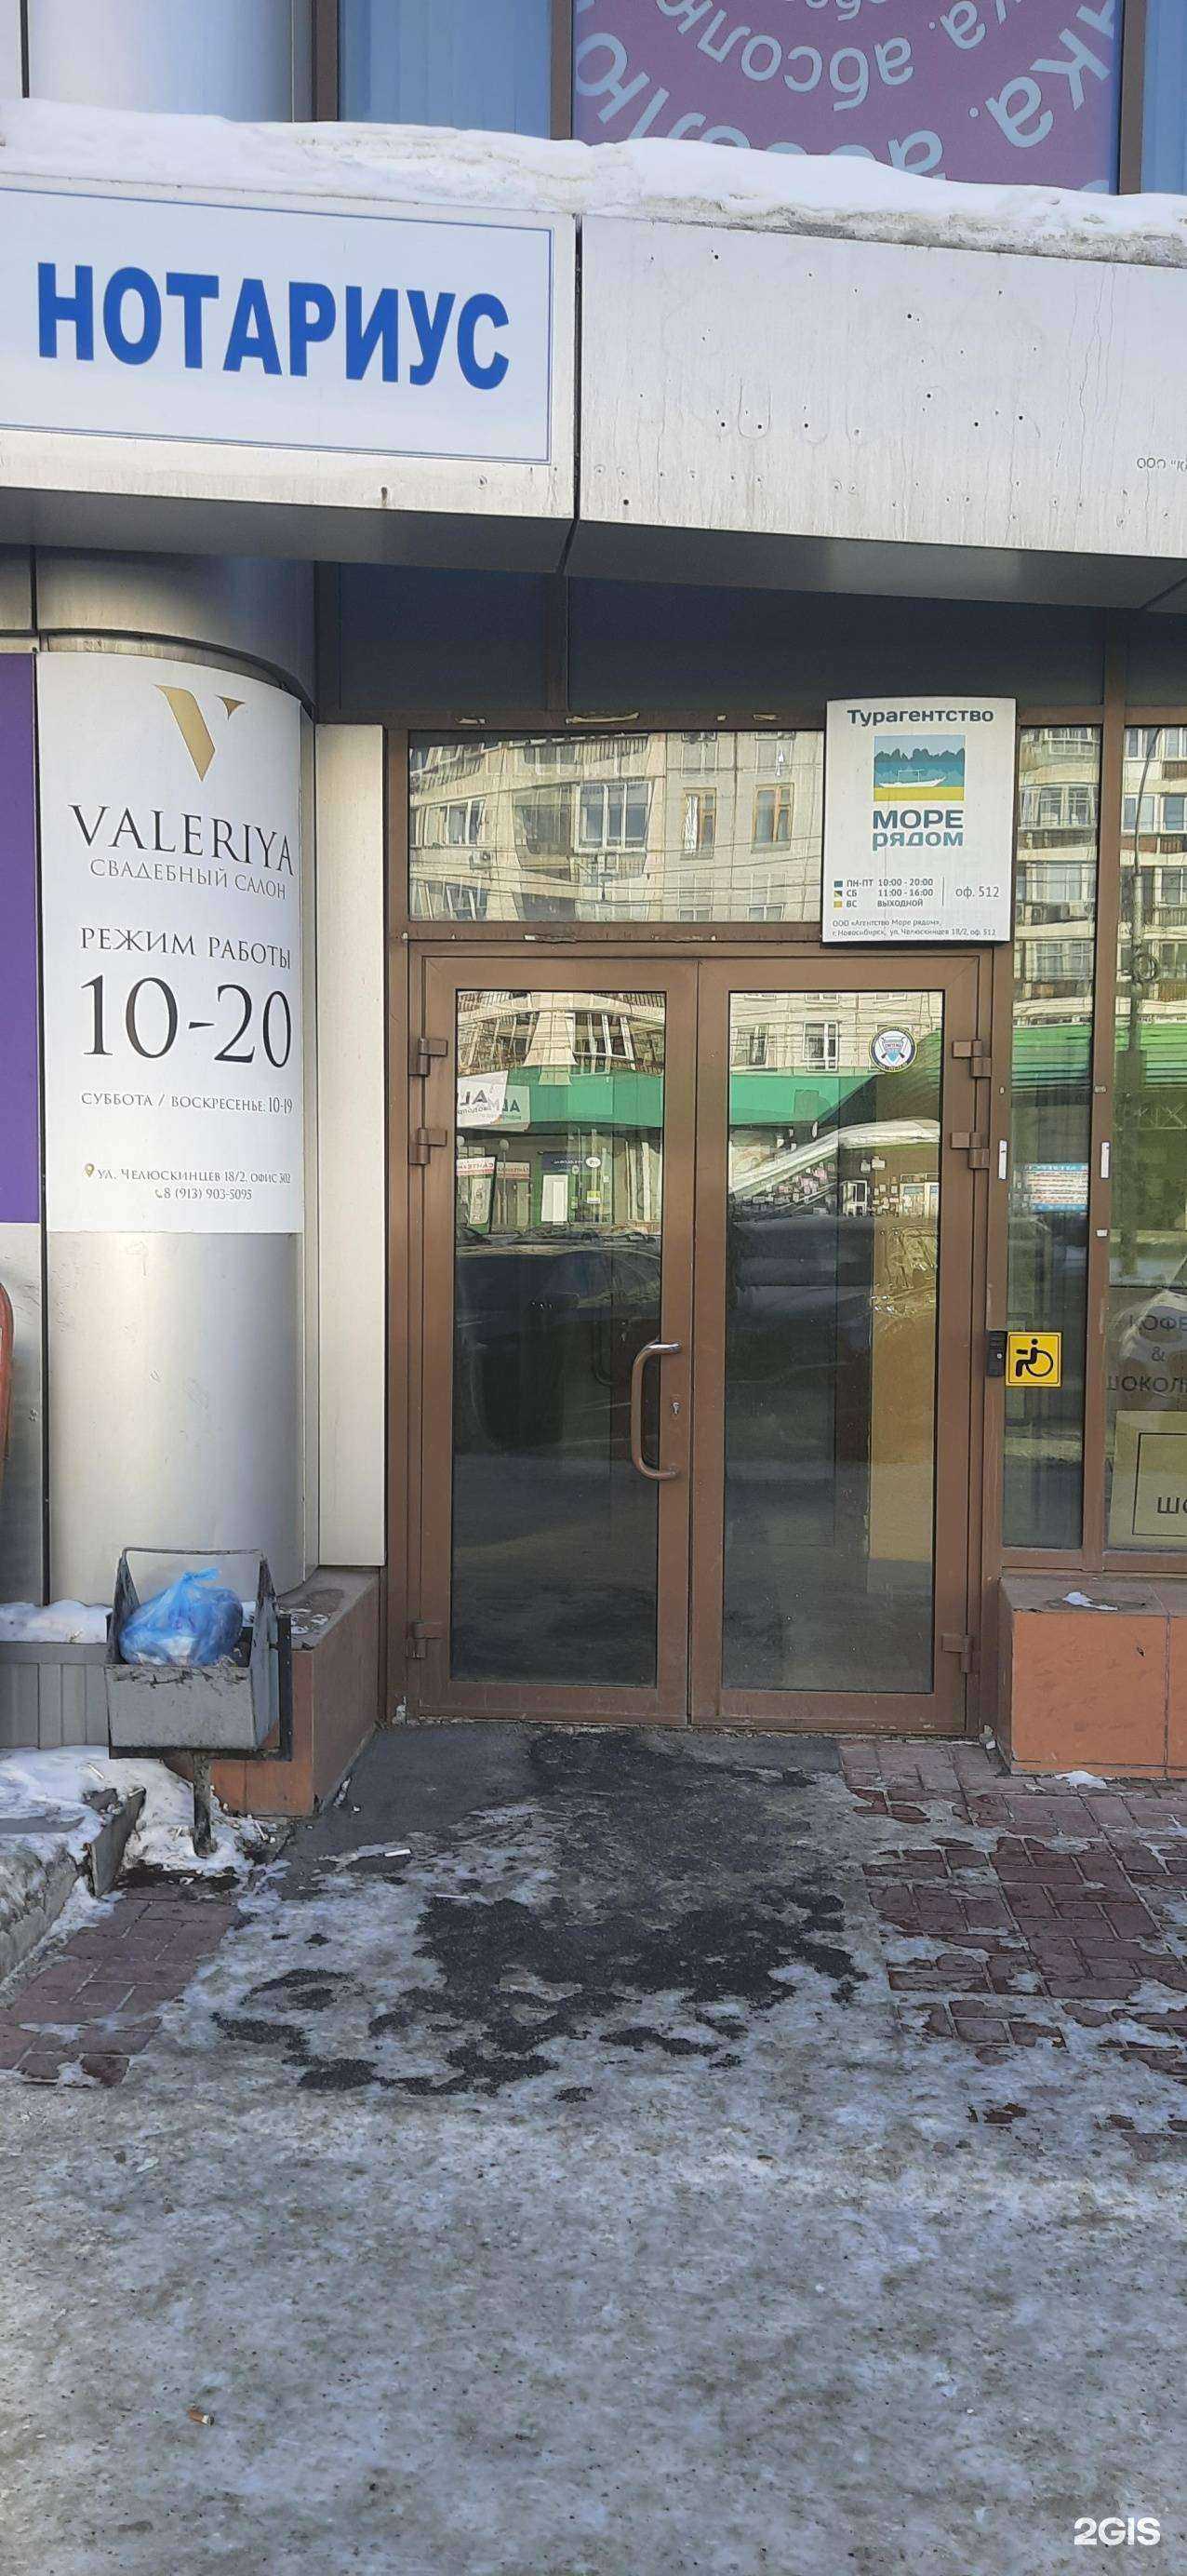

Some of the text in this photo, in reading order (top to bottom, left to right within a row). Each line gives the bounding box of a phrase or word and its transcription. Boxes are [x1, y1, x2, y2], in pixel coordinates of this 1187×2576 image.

[37, 262, 510, 390] НОТАРИУС
[847, 709, 994, 727] Турагентство
[873, 810, 964, 829] МОРЕ
[68, 804, 295, 878] VALERIYA
[90, 858, 287, 900] СВАДЕБНЫЙ САЛОН
[847, 879, 874, 887] ПН-ПТ
[878, 878, 902, 887] 10:00
[909, 878, 934, 886] 20:00
[847, 889, 858, 897] СБ
[878, 889, 902, 897] 11:00
[909, 889, 934, 897] 16:00
[955, 886, 999, 899] оф. 512
[877, 899, 924, 907] ВЫХОДНОЙ
[81, 927, 291, 970] РЕЖИМ РАБОТЫ
[80, 974, 292, 1069] 10-20
[81, 1093, 293, 1115] СУББОТА / ВОСКРЕСЕНЬЕ: 10-19
[98, 1168, 116, 1180] УЛ.
[121, 1168, 221, 1183] ЧЕЛЮСКИНЦЕВ
[224, 1171, 248, 1183] 18/2,
[250, 1173, 278, 1184] ОФИС
[164, 1187, 252, 1201] 8 (913) 903-5095
[1152, 1347, 1166, 1362] &
[1157, 1496, 1187, 1514] Ш
